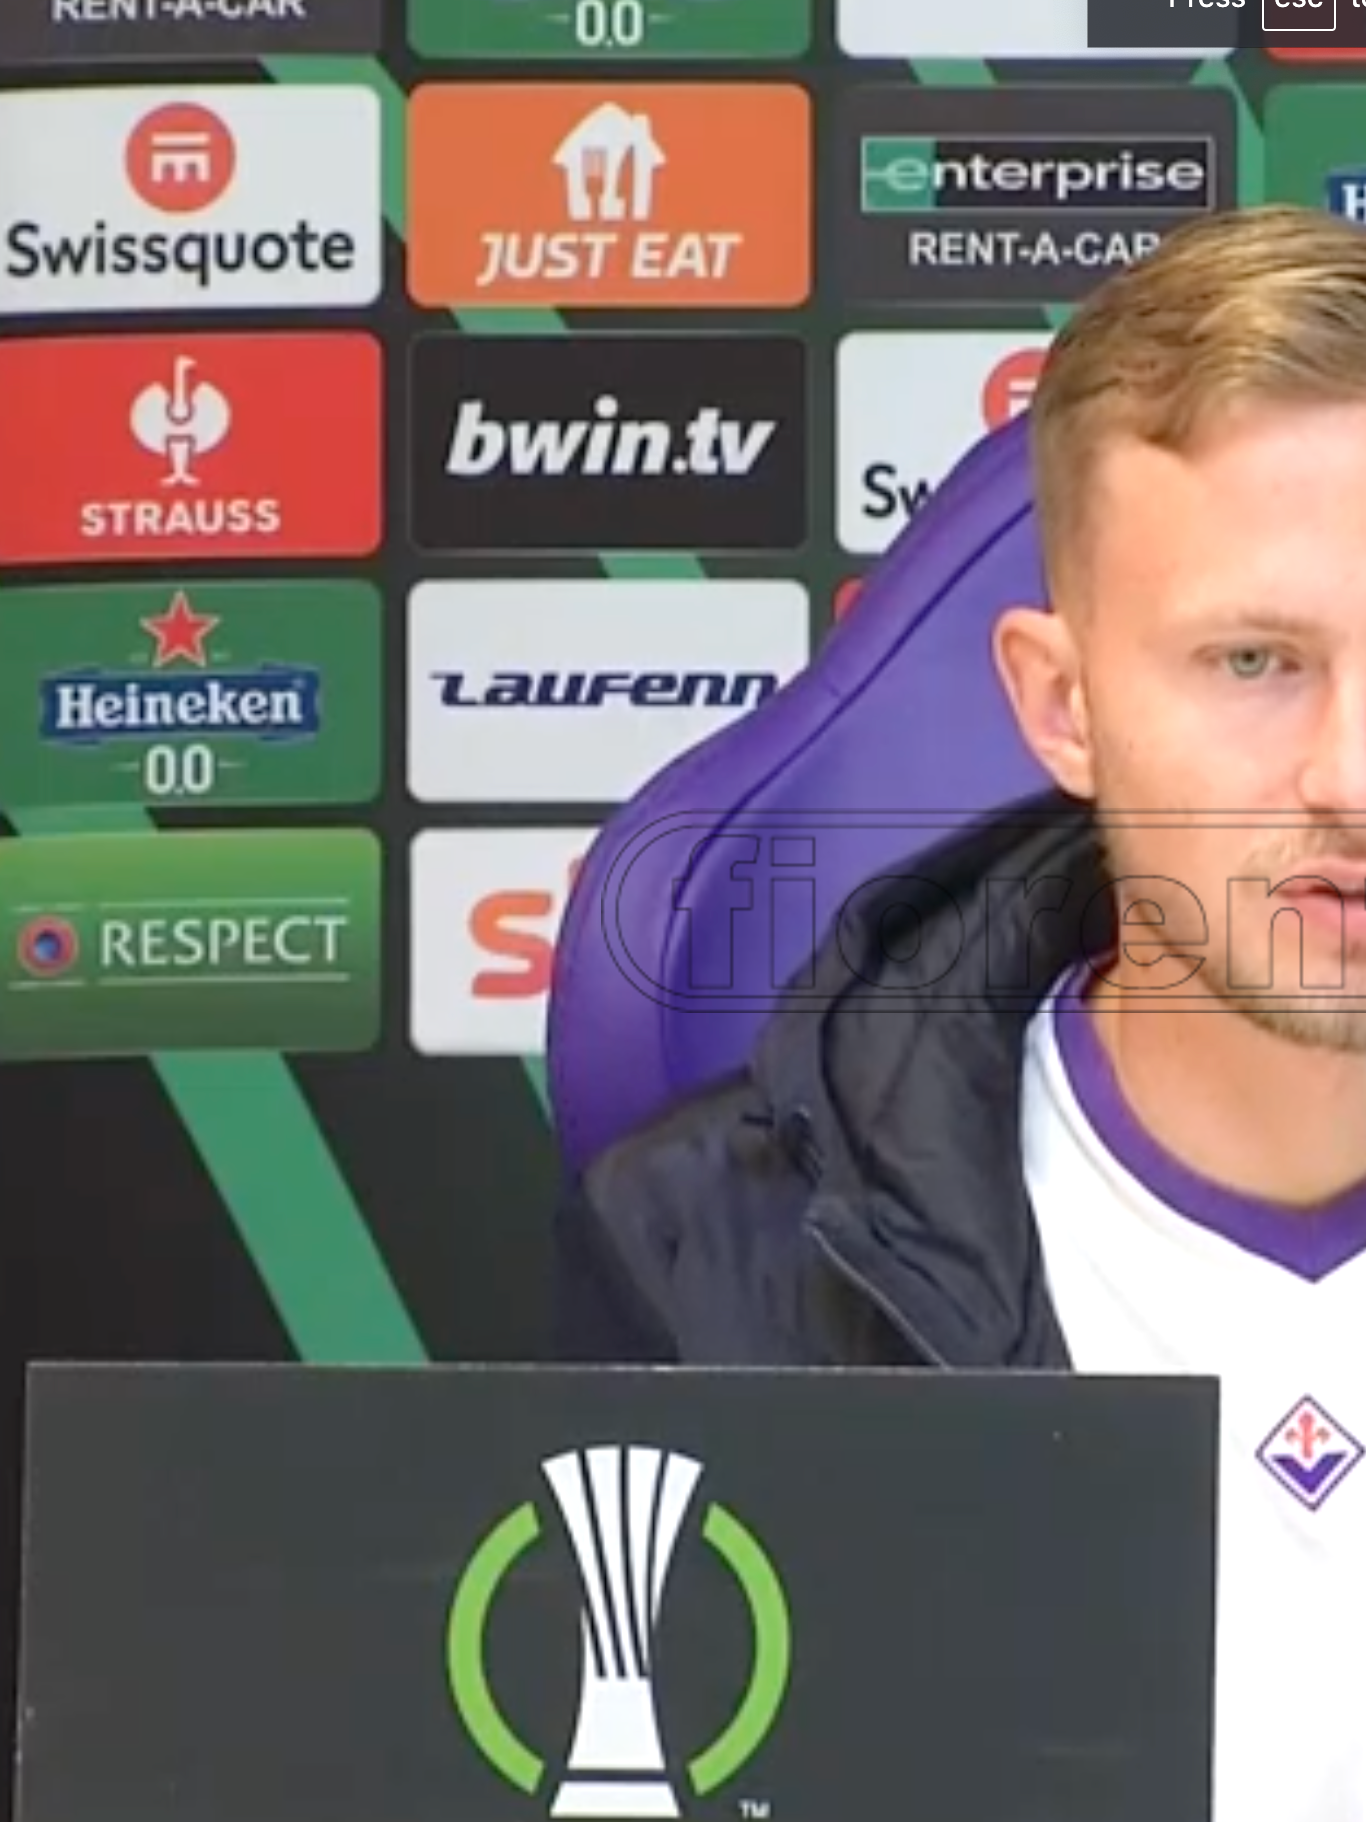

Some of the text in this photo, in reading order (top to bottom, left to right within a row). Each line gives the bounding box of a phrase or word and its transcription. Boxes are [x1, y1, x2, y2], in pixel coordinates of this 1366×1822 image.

[884, 151, 1205, 201] enterprise
[5, 219, 356, 287] Swissquote
[476, 232, 742, 287] JUST EAT
[446, 395, 776, 476] bwin.tv
[80, 499, 281, 537] STRAUSS
[55, 680, 303, 729] Heineken
[145, 743, 214, 796] 0.0
[101, 915, 349, 967] RESPECT
